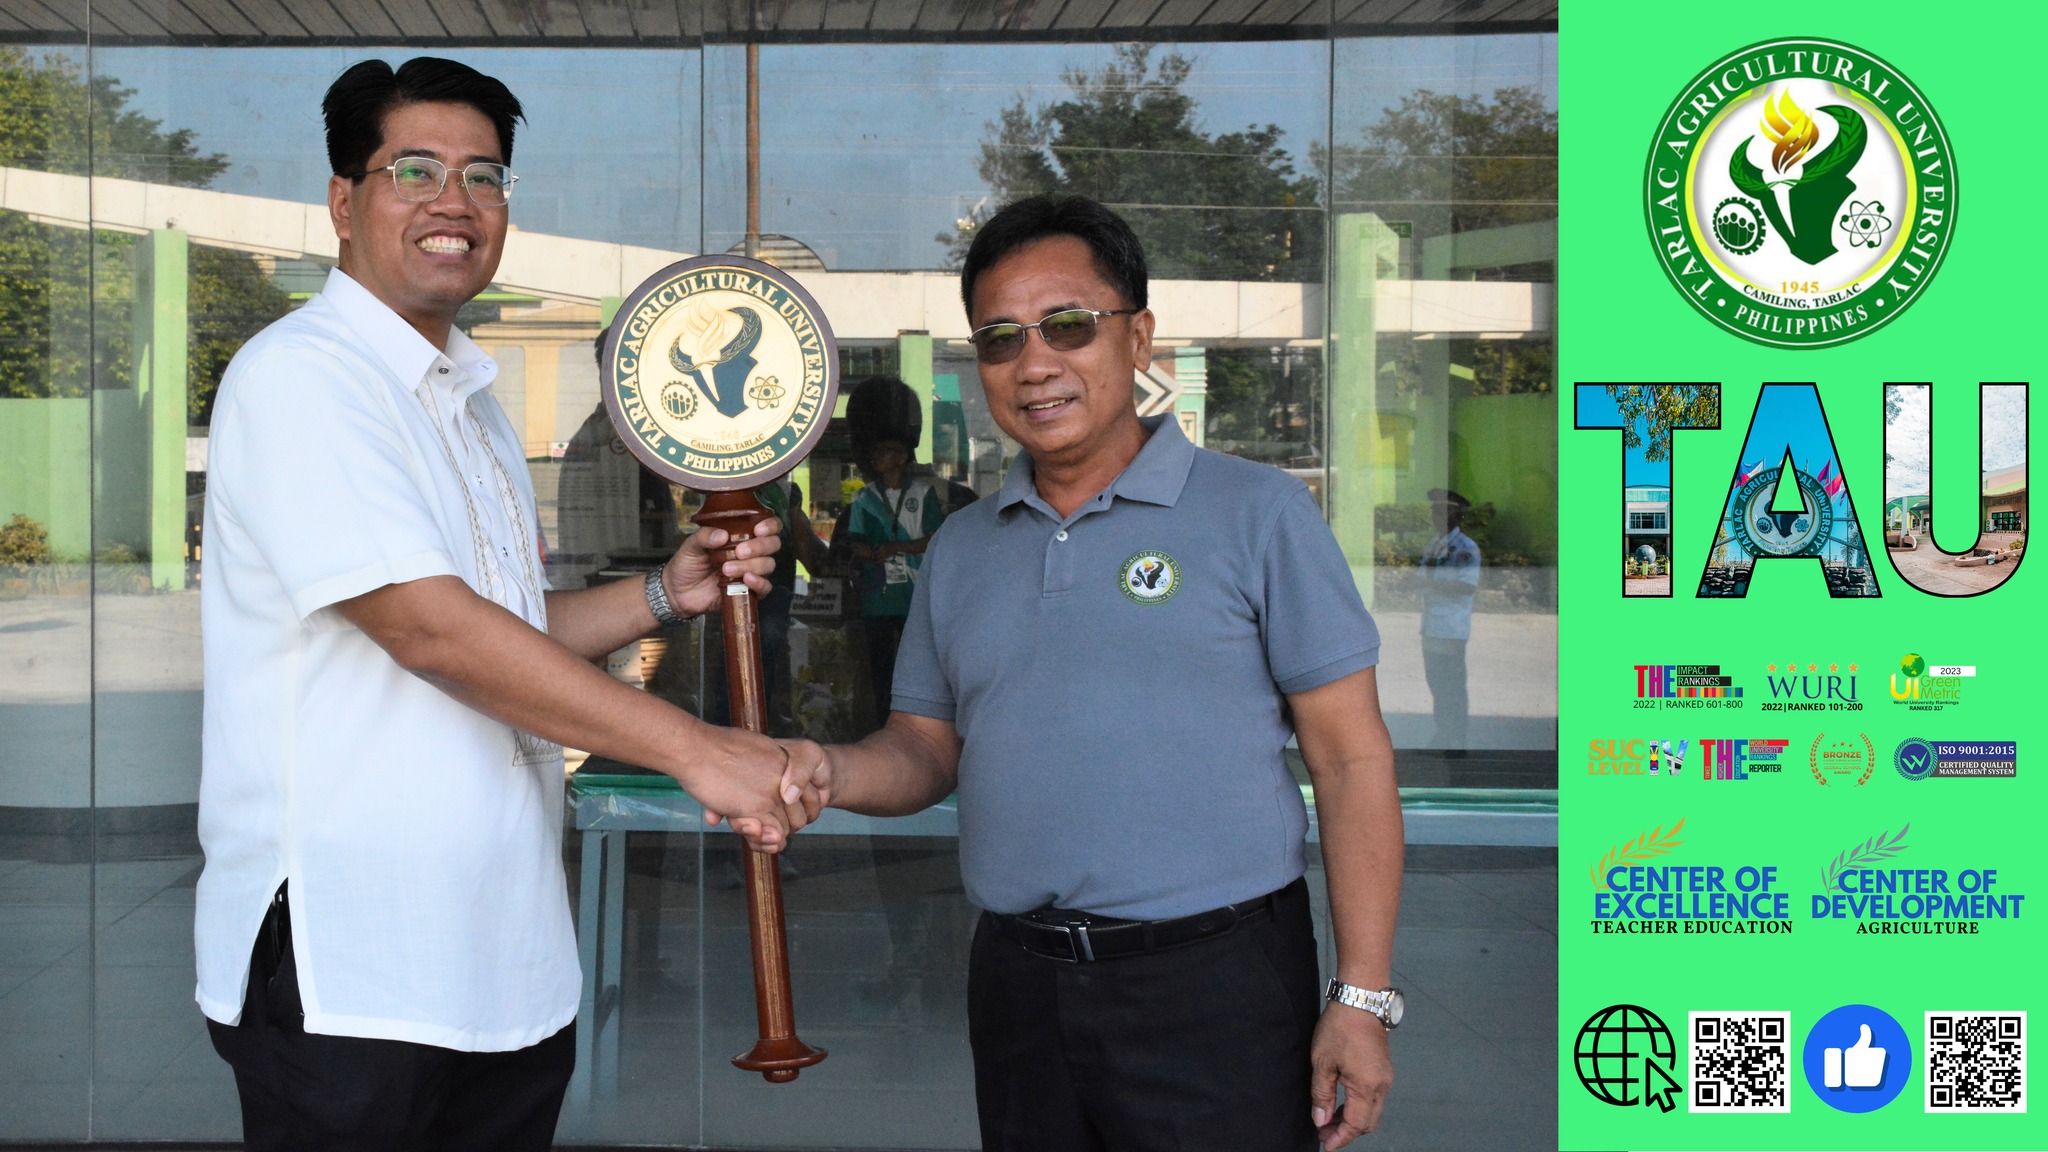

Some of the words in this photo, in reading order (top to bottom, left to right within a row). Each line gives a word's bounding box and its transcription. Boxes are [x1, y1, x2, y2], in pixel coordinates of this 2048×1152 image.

[624, 271, 778, 356] AGRICULTURAL
[619, 357, 666, 449] TARLAC
[780, 297, 823, 439] UNIVERSITY
[682, 445, 776, 472] PHILIPPINES
[734, 433, 765, 450] TARLAC
